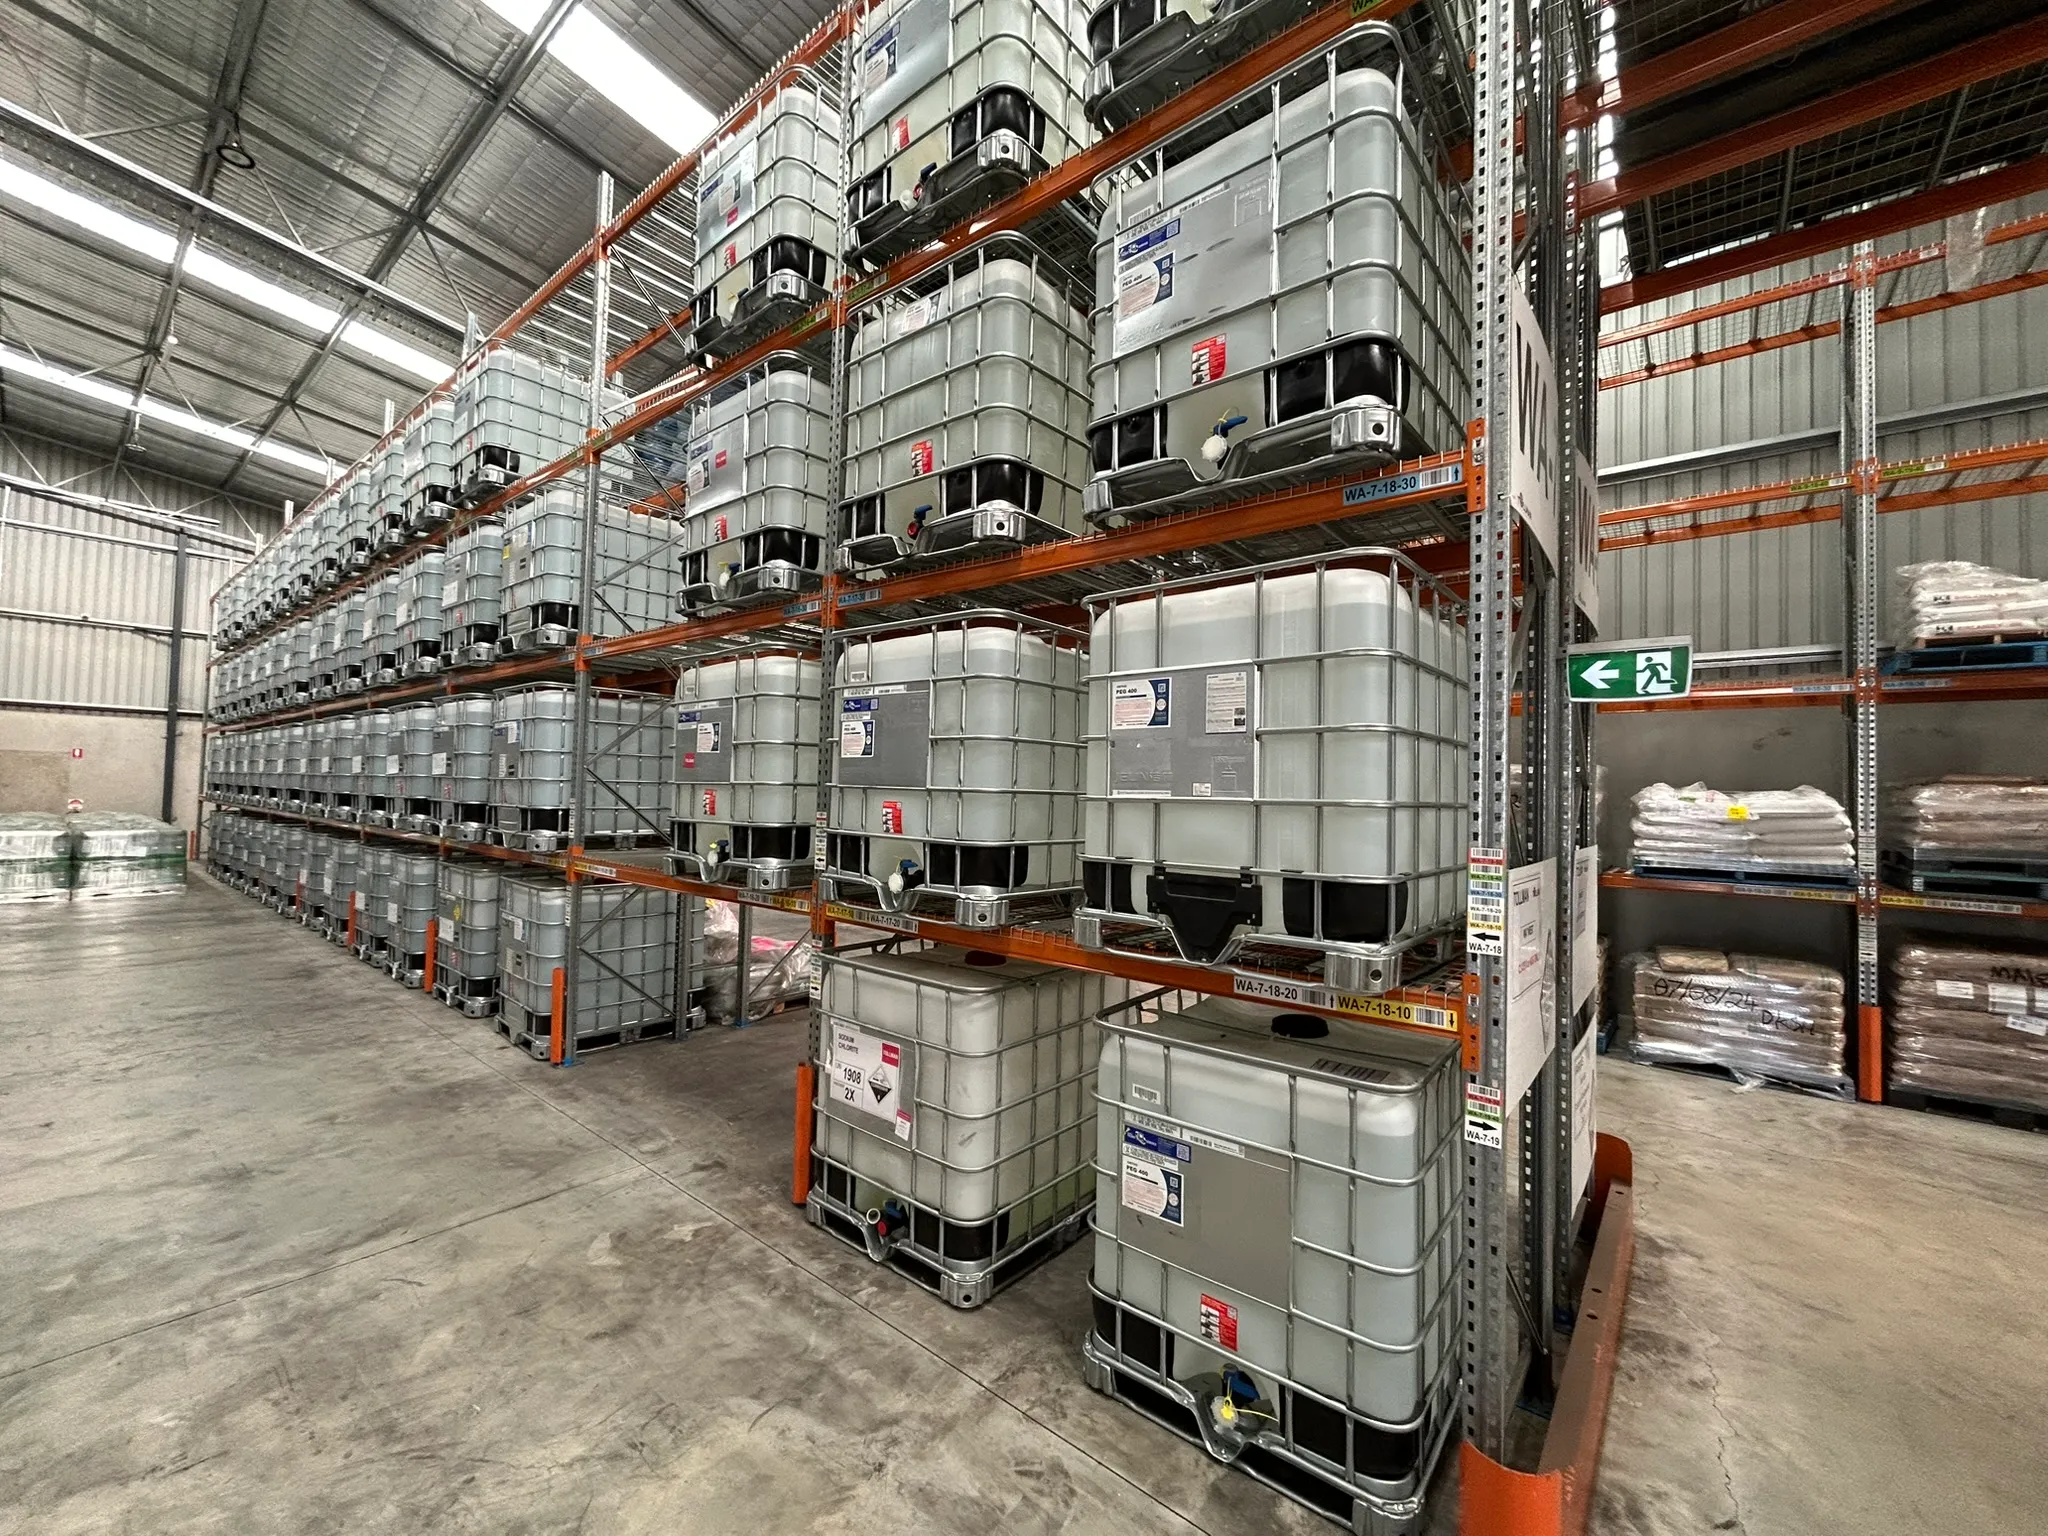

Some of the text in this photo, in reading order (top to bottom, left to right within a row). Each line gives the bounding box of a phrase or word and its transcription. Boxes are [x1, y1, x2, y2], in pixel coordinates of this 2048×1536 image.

[1344, 476, 1417, 502] WA-7-18-30
[870, 914, 901, 929] WA-7-17-20
[1469, 942, 1502, 955] WA-7-18
[1235, 977, 1299, 1001] WA-7-18-20
[1338, 995, 1412, 1021] WA-7-18-10
[838, 1033, 854, 1043] SODIUM
[838, 1042, 858, 1054] CHLORITE
[843, 1067, 861, 1084] 1908
[844, 1087, 855, 1102] 2X
[1466, 1130, 1500, 1145] WA-7-19
